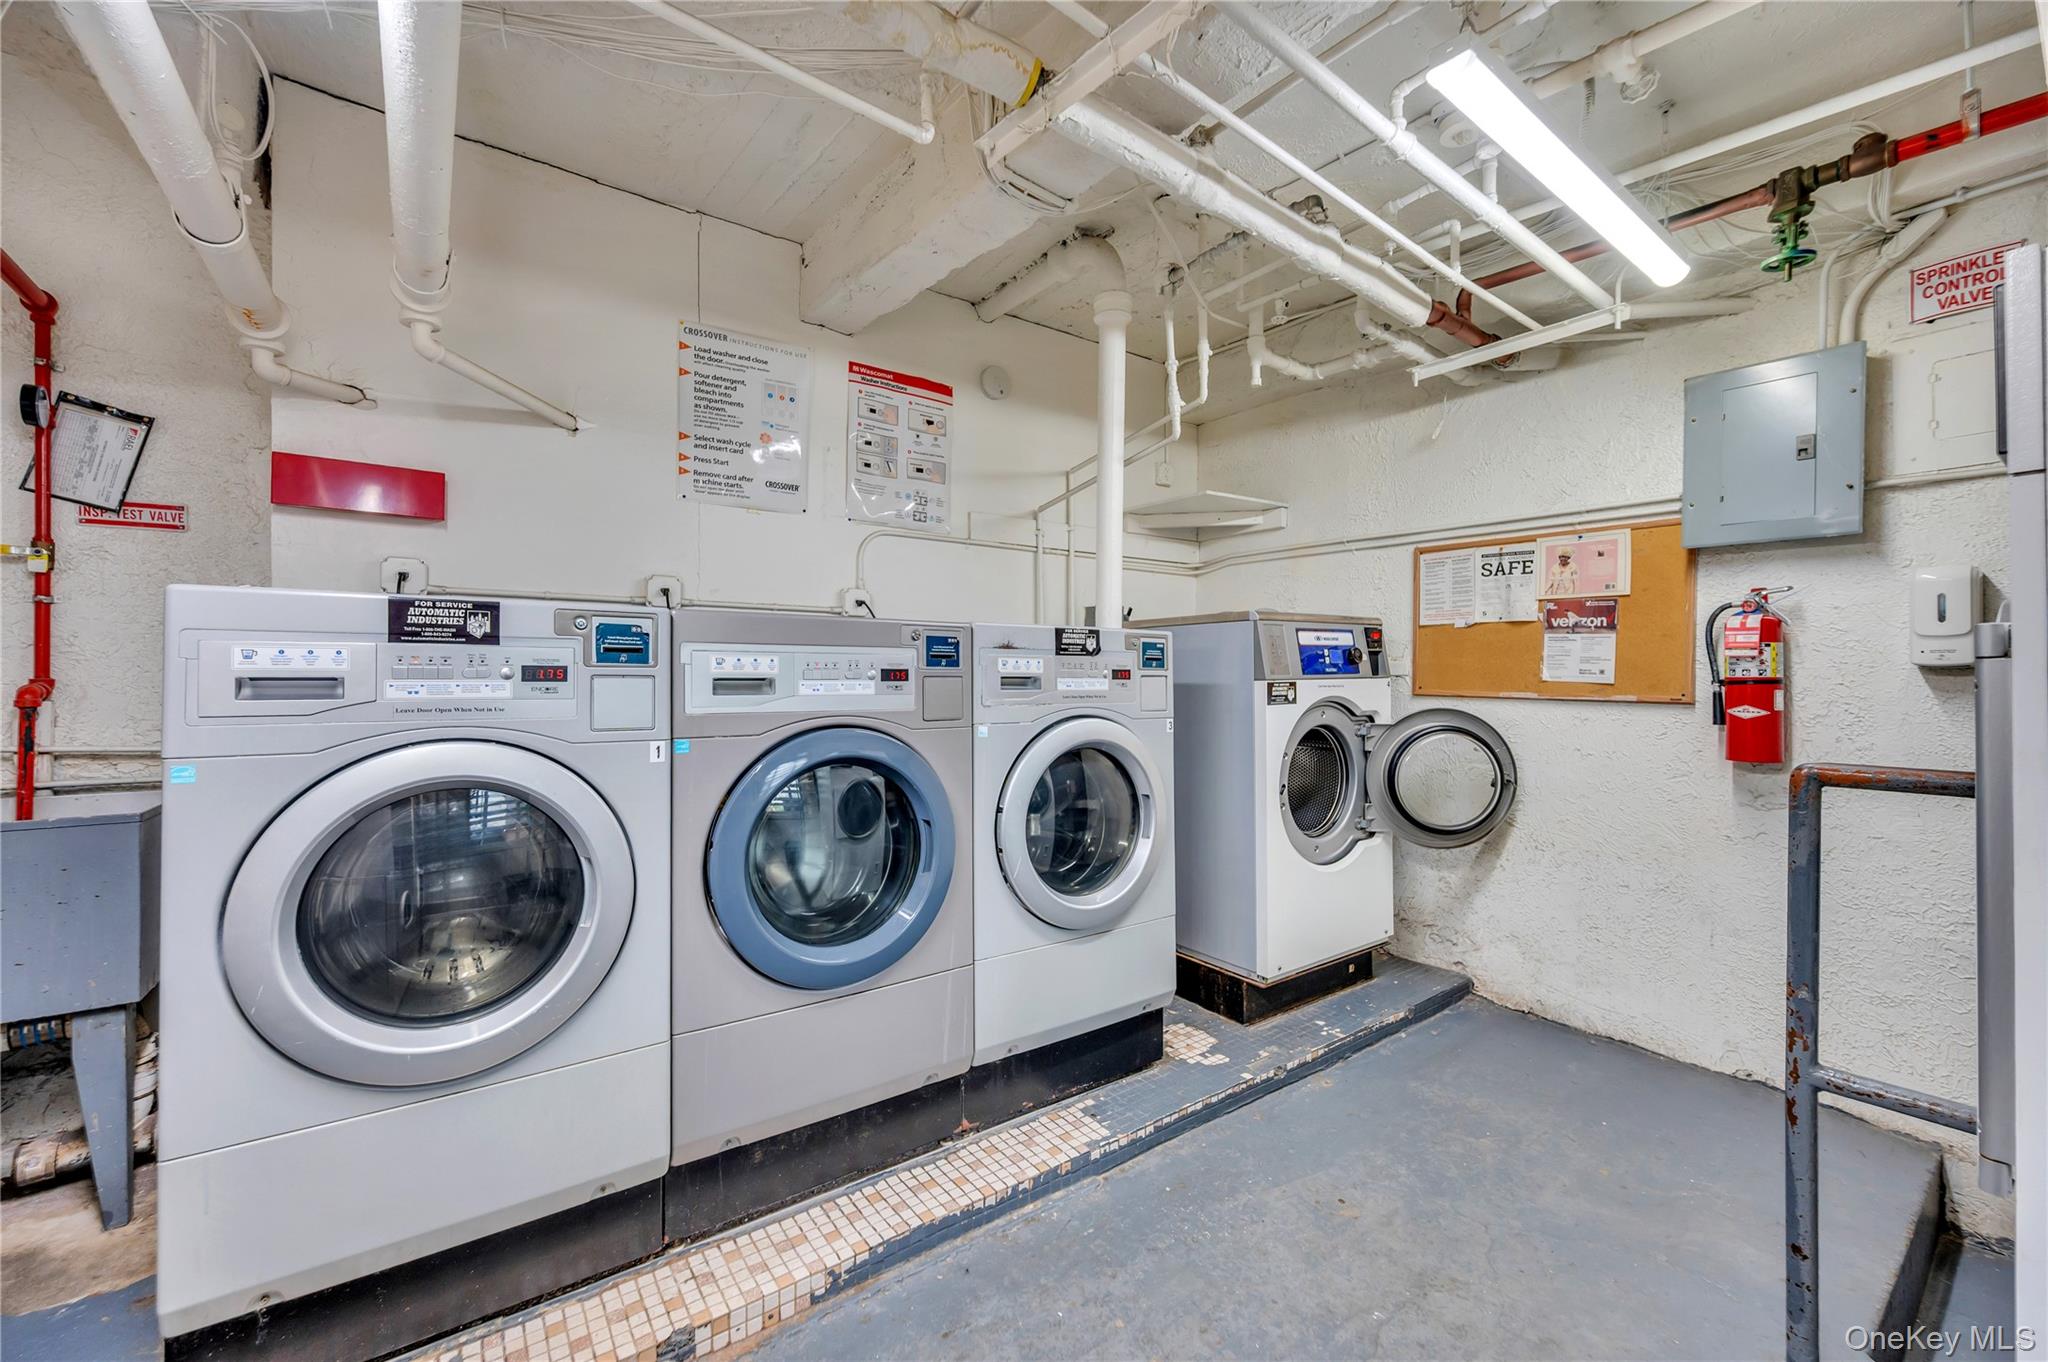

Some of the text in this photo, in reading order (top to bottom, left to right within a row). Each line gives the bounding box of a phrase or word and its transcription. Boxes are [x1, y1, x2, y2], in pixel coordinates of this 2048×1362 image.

[1938, 286, 1994, 310] VALVE
[684, 327, 728, 342] CROSSOVER
[730, 338, 778, 352] INSTRUCTIONS
[694, 346, 768, 365] Load washer and close
[706, 356, 724, 364] door.
[694, 371, 746, 387] Pour detergent,
[860, 367, 894, 380] Wascomat
[694, 380, 736, 392] softener and
[860, 376, 908, 391] Washer Instructions
[694, 387, 732, 398] bleach into
[694, 395, 744, 408] compartments
[702, 403, 728, 412] shown.
[694, 434, 751, 448] Select wash cycle
[708, 444, 727, 452] insert
[694, 456, 728, 466] Press Start
[694, 469, 720, 478] Remove
[722, 473, 736, 481] card
[766, 481, 800, 492] CROSSOVER
[150, 511, 184, 523] VALVE
[1481, 560, 1534, 577] SAFE
[408, 608, 465, 616] AUTOMATIC
[407, 616, 464, 624] INDUSTRIES
[1551, 617, 1607, 627] verzon
[1168, 721, 1173, 730] 3
[656, 746, 660, 758] 1
